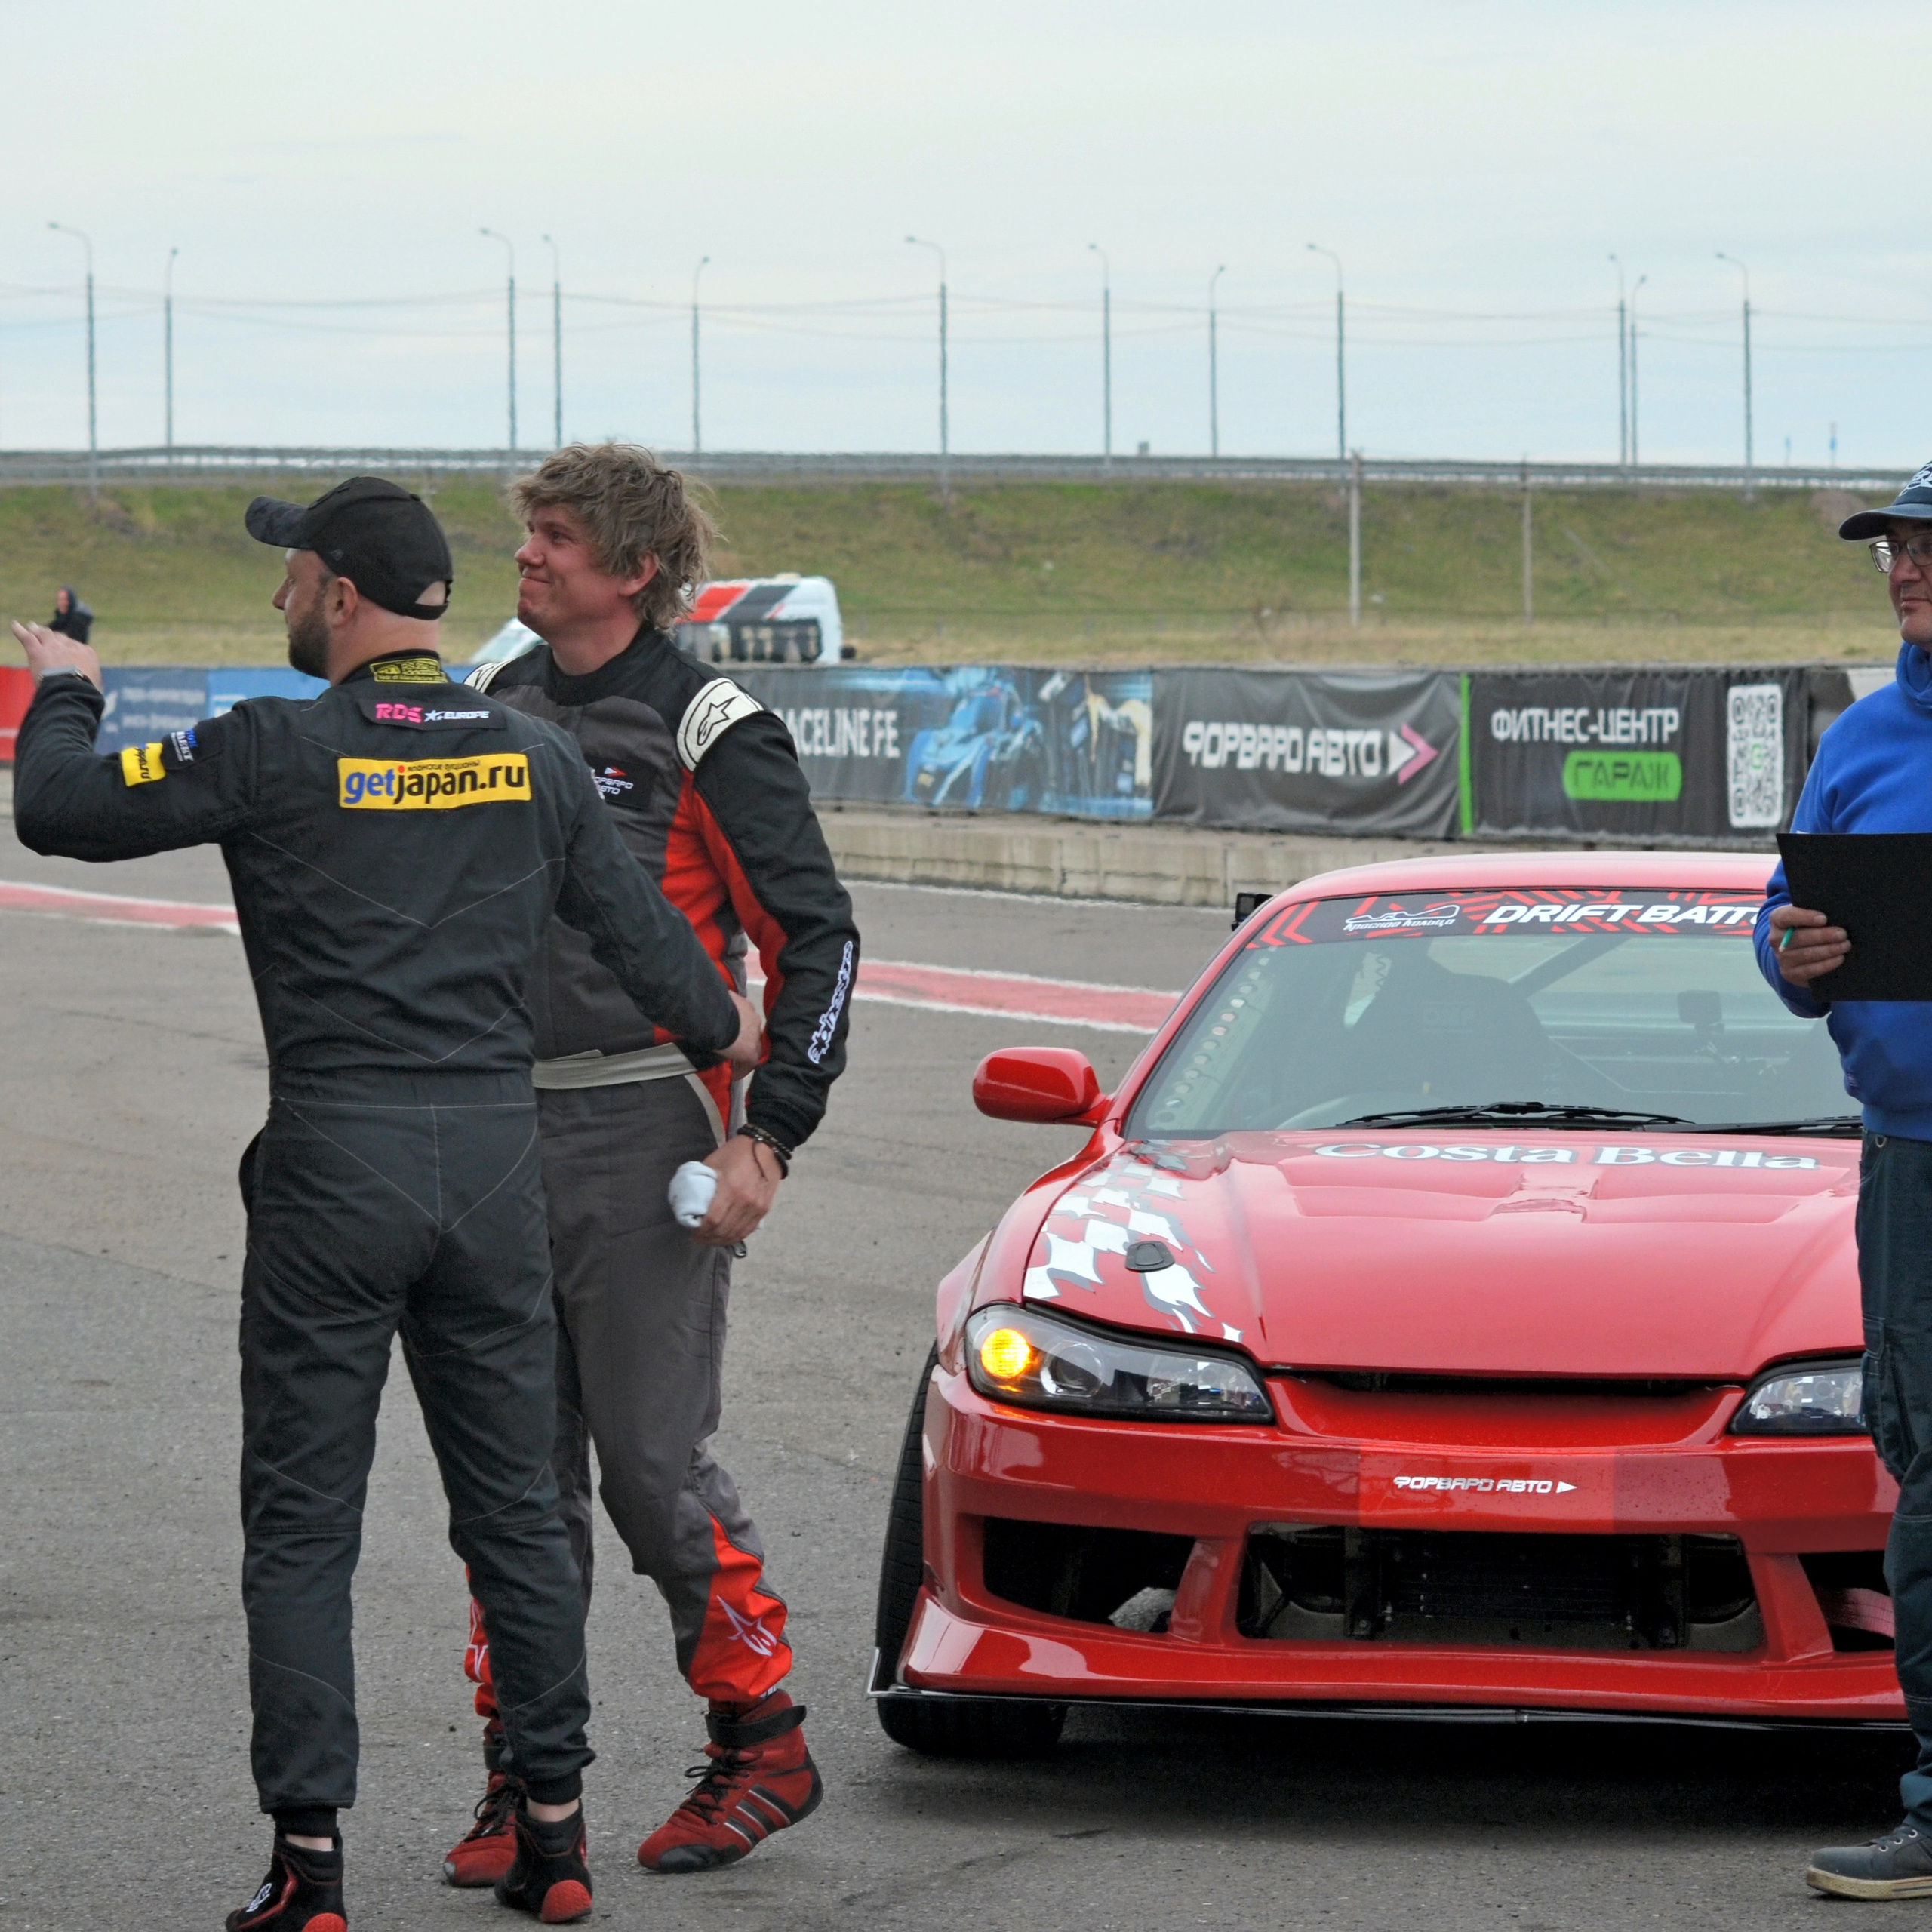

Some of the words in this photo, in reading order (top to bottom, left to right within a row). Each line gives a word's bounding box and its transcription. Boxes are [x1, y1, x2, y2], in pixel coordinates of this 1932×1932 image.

[376, 703, 423, 724] RDS
[442, 710, 490, 720] EUROPE
[1491, 707, 1680, 743] ФИТНЕС-ЦЕНТР
[343, 765, 525, 805] getjapan.ru
[1574, 761, 1671, 789] ГАРАЖ
[1483, 904, 1644, 924] DRIFT
[1594, 1146, 1818, 1170] Bella
